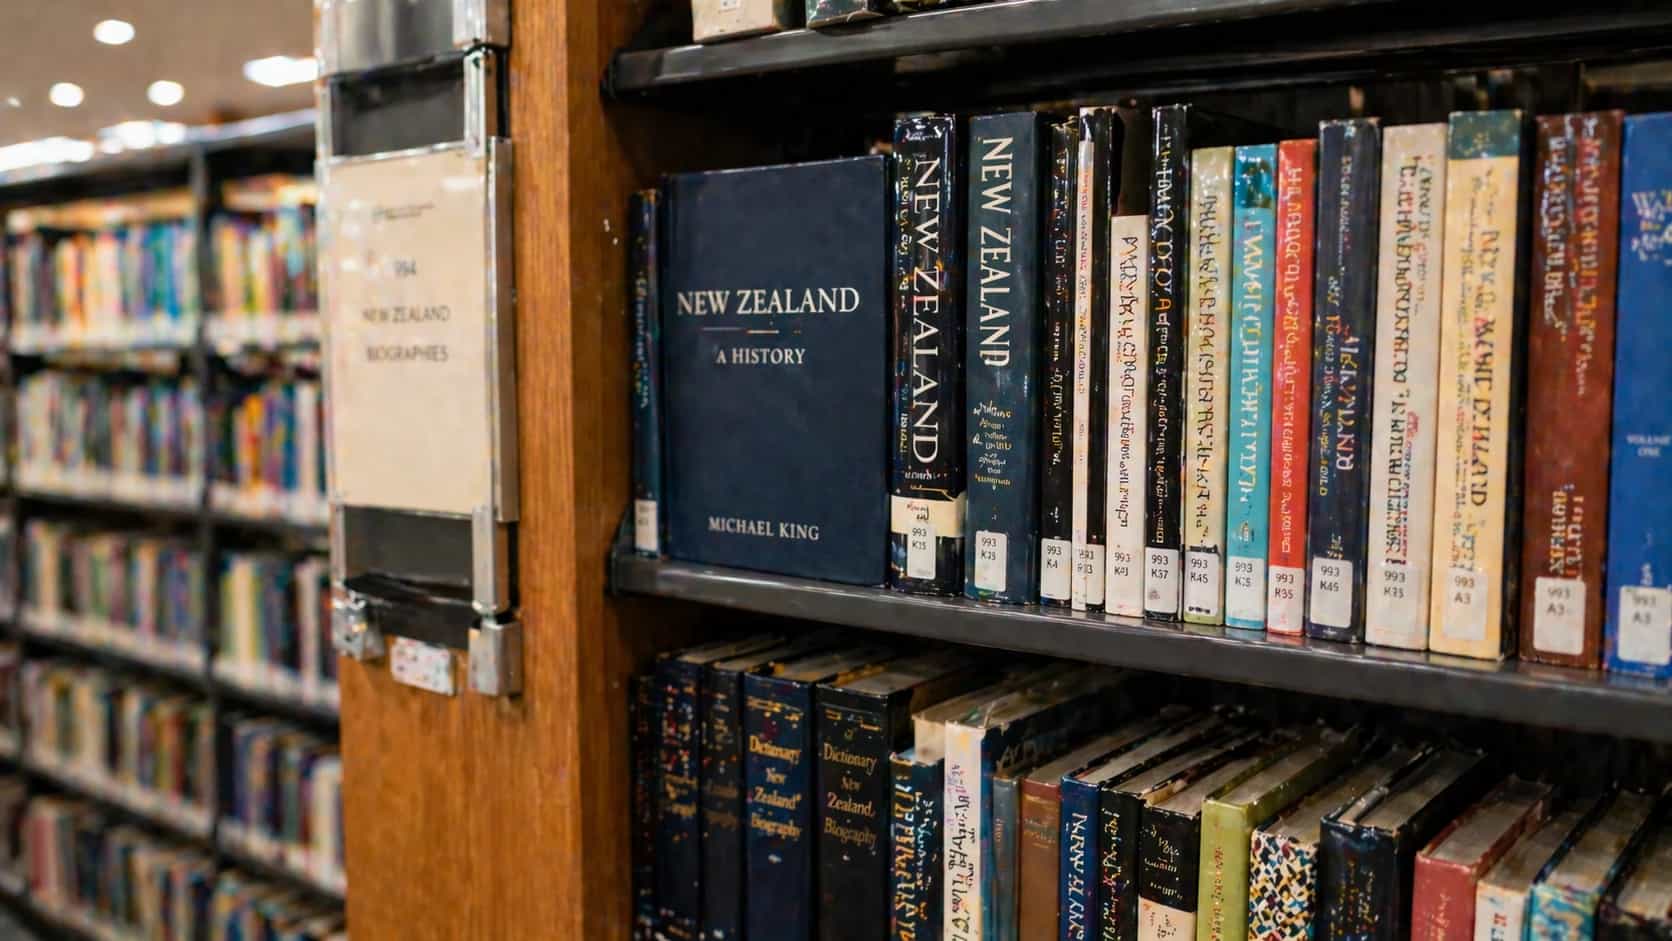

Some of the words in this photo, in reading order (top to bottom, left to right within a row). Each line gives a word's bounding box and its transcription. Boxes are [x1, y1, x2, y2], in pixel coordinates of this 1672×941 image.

[980, 136, 1014, 214] NEW
[914, 156, 941, 254] NEW
[677, 290, 730, 316] NEW
[735, 286, 860, 315] ZEALAND
[979, 225, 1012, 367] ZEALAND
[362, 307, 389, 322] NEW
[391, 304, 451, 324] ZEALAND
[365, 344, 449, 363] BIOGRAPHIES
[716, 350, 727, 365] A
[732, 348, 806, 365] HISTORY
[912, 265, 940, 464] ZEALAND
[708, 516, 775, 537] MICHAEL
[779, 521, 820, 541] KING
[911, 527, 928, 538] 993
[981, 537, 997, 548] 993
[1046, 545, 1062, 556] 993
[1114, 551, 1131, 563] 993
[1151, 554, 1169, 566] 993
[1191, 558, 1209, 569] 993
[1234, 561, 1253, 574] 993
[1320, 565, 1340, 577] 993
[1275, 572, 1295, 585] 993
[1384, 570, 1406, 583] 993
[1454, 575, 1475, 589] 993
[1454, 591, 1472, 605] A3
[823, 741, 878, 776] Dictionary
[823, 816, 878, 850] Biography
